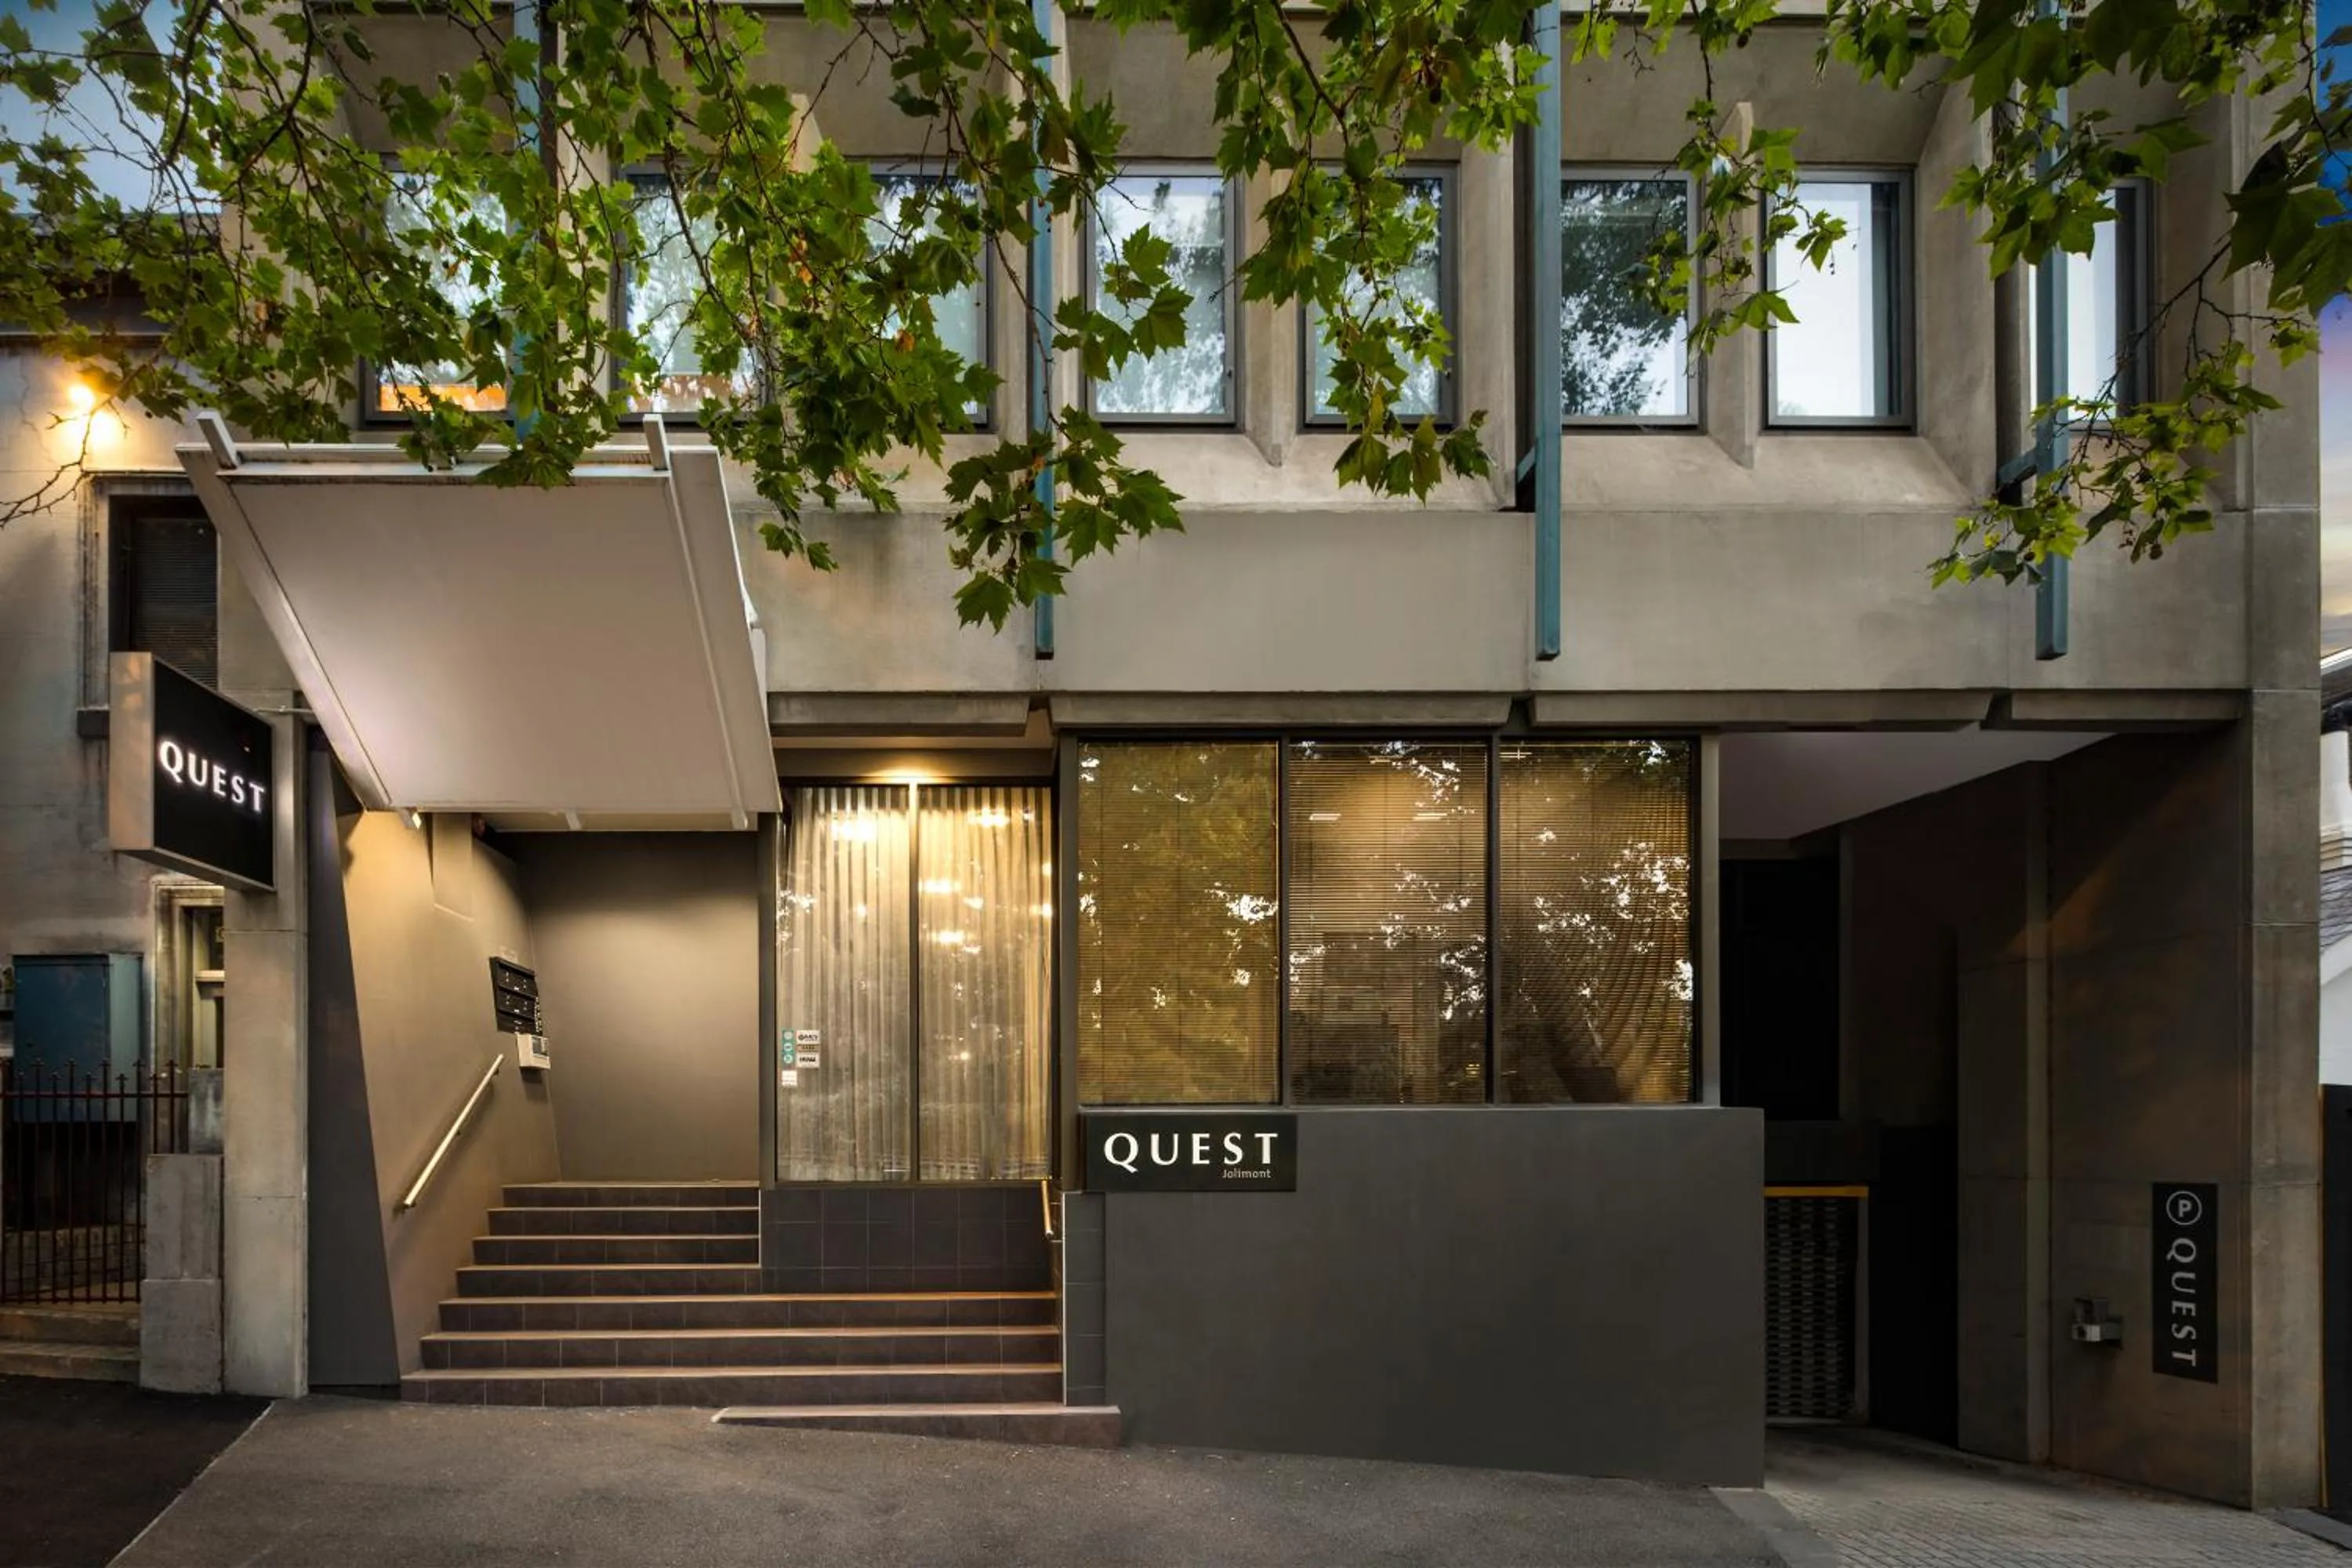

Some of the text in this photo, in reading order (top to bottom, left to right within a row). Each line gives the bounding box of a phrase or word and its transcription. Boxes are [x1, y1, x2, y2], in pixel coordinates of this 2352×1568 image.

[158, 740, 265, 812] QUEST
[1104, 1132, 1279, 1173] QUEST
[1222, 1168, 1271, 1178] Jolimont
[2177, 1199, 2192, 1218] P
[2166, 1238, 2197, 1367] QUEST
